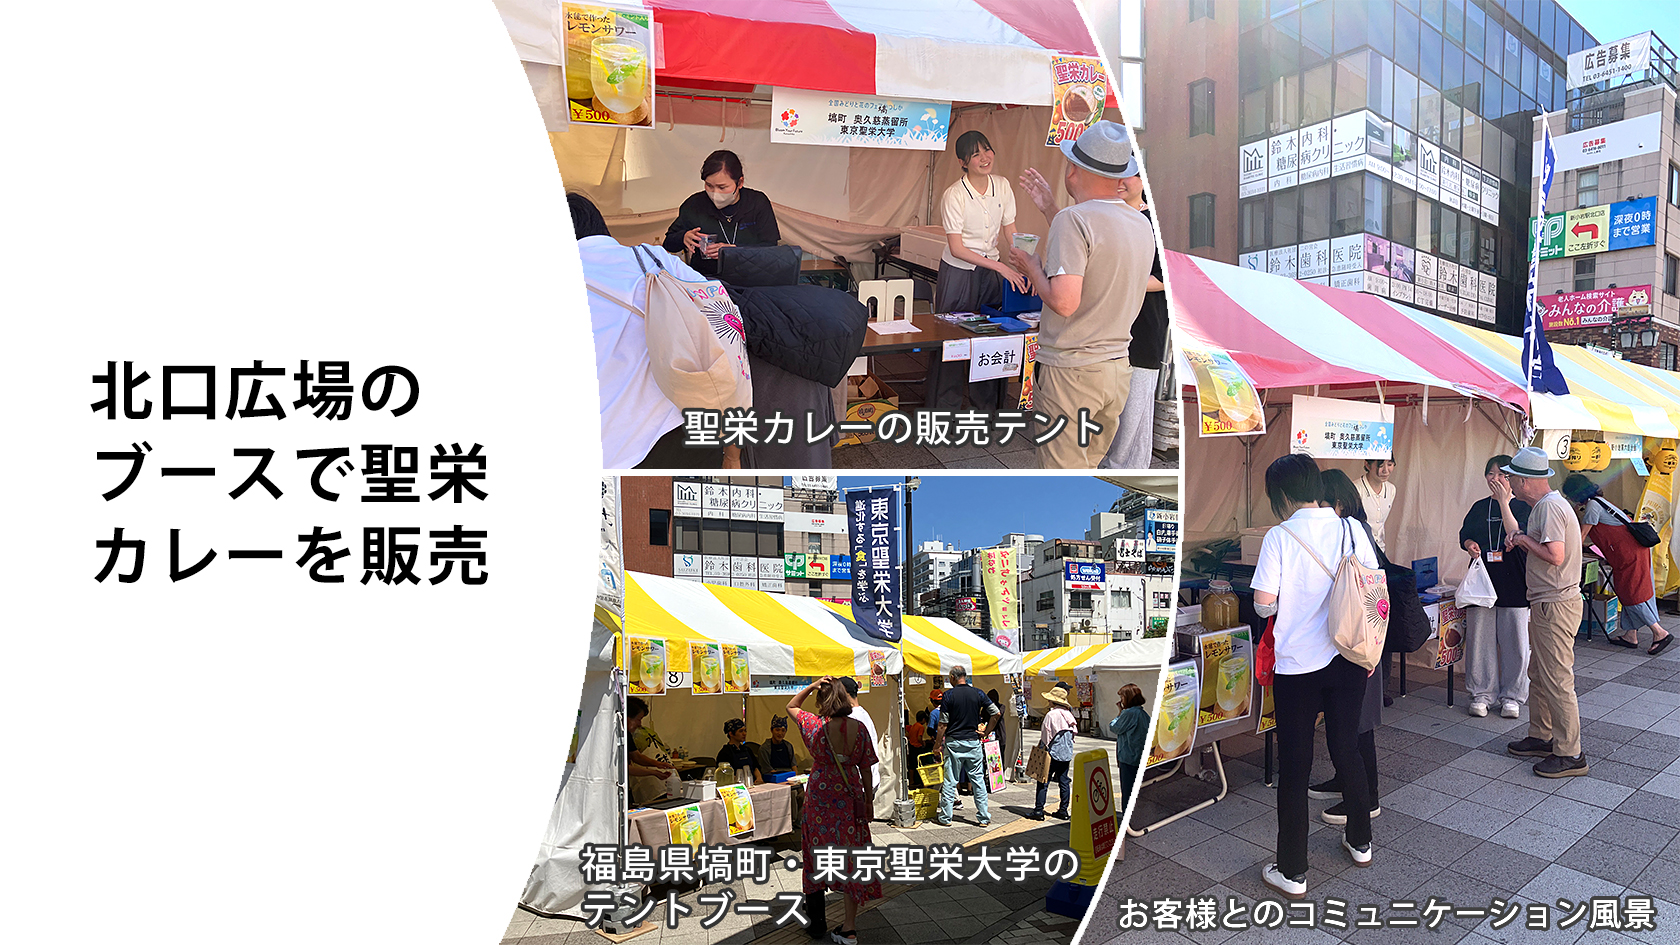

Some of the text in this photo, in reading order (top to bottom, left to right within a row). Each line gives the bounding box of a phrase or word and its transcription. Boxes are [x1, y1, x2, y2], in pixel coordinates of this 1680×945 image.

[567, 21, 637, 36] レモンサワー
[1584, 42, 1631, 70] 広告募集
[1054, 62, 1105, 84] 聖栄カレー
[1593, 64, 1632, 80] 03-6451-1400
[573, 108, 611, 121] ¥500
[828, 112, 909, 127] 塙町 奥久慈蒸留所
[840, 126, 896, 137] 東京聖栄大学
[1276, 136, 1364, 171] 糖尿病クリニック
[1570, 209, 1605, 221] 新小岩駅北口店
[1613, 210, 1651, 225] 深夜0時
[1613, 223, 1651, 237] まで営業
[1568, 240, 1605, 252] ここ左折すぐ
[1270, 243, 1362, 273] 鈴木歯科医院
[1558, 291, 1616, 302] 老人ホーム検索サイト
[1548, 297, 1625, 317] みんなの介護
[978, 350, 1015, 367] お会計
[1204, 421, 1232, 432] ¥500
[1331, 441, 1364, 450] 東京聖栄大学
[709, 497, 783, 511] 糖尿病クリニック
[704, 560, 783, 574] 鈴木歯科医院
[1070, 574, 1101, 582] 処方せん受付
[1205, 645, 1244, 659] レモンサワー
[1164, 681, 1188, 694] サワー
[1200, 711, 1224, 724] ¥500
[1093, 820, 1114, 840] 走行禁止
